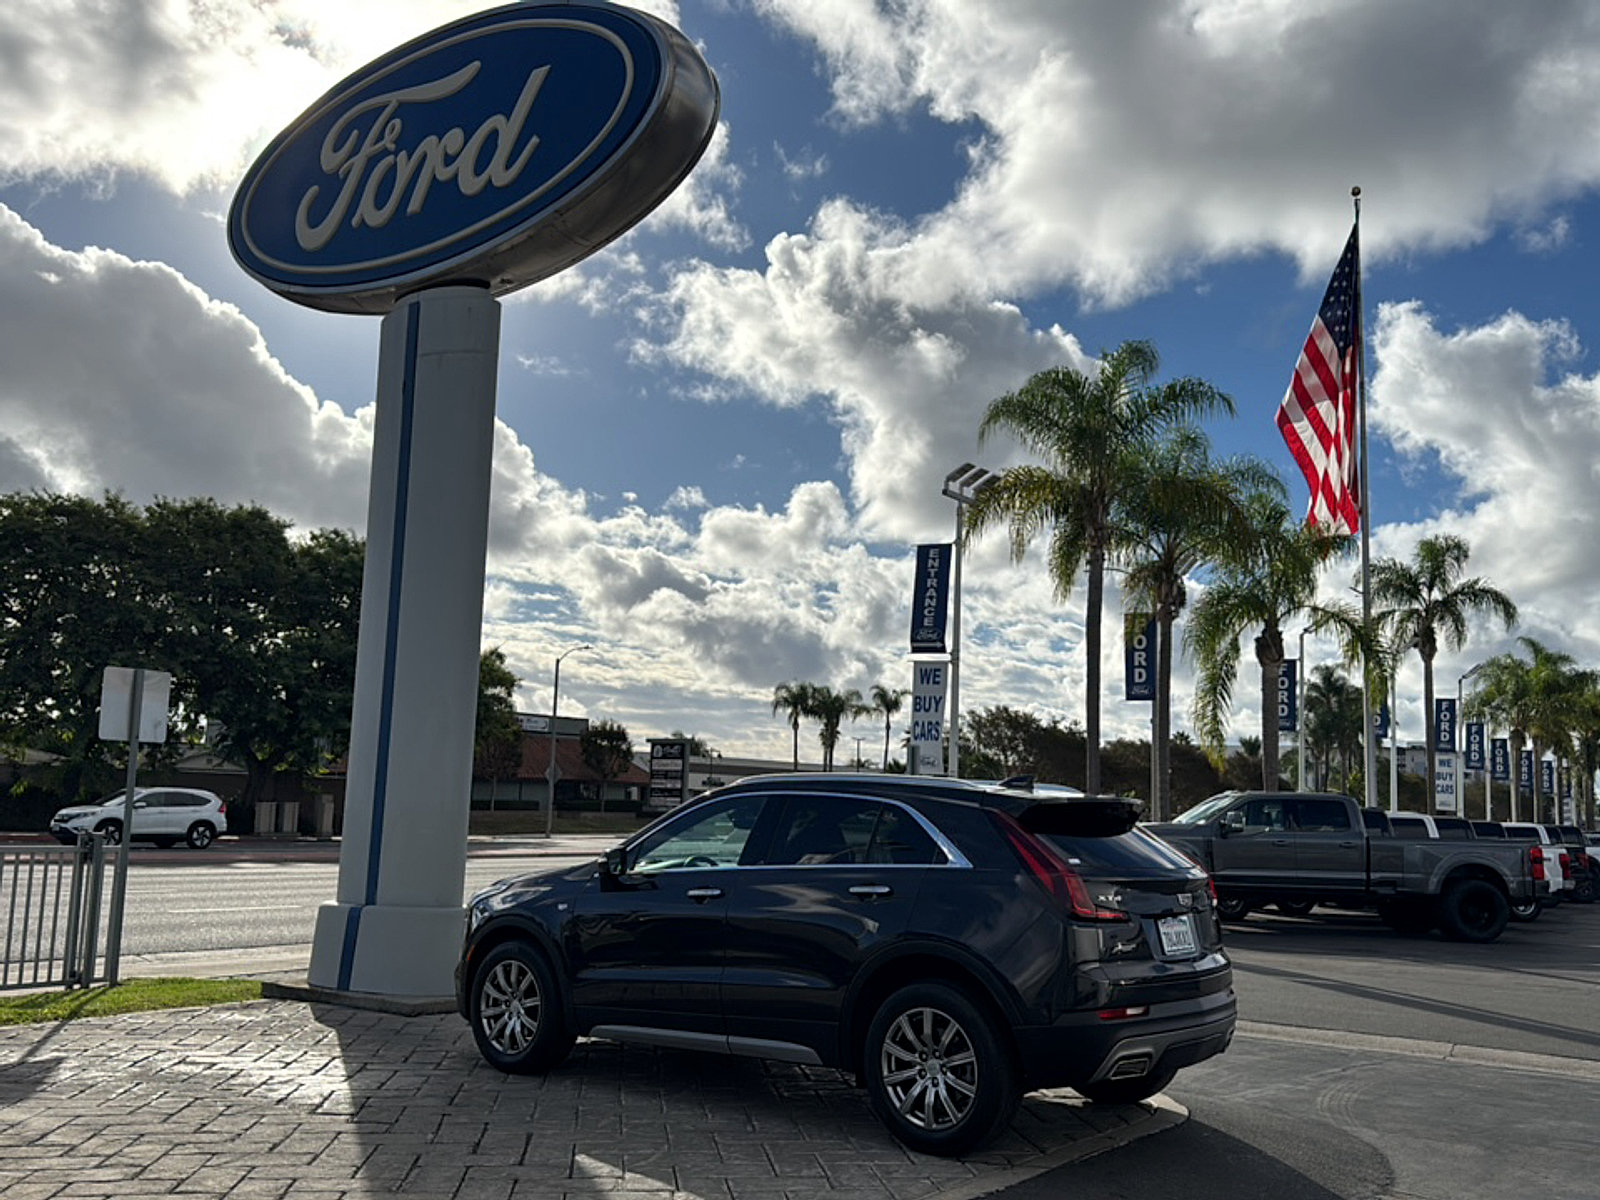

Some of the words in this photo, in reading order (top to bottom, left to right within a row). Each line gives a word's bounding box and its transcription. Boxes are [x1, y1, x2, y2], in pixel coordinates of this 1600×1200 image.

[295, 60, 551, 251] Ford
[923, 548, 940, 627] ENTRANCE
[920, 667, 942, 685] WE
[1278, 663, 1289, 717] FORD
[914, 695, 942, 713] BUY
[913, 721, 940, 741] CARS
[1440, 701, 1451, 742] FORD
[1470, 725, 1480, 761] FORD
[1495, 741, 1504, 772] FORD
[1437, 772, 1453, 781] BUY
[1520, 752, 1529, 780] FORD
[1437, 784, 1454, 794] CARS
